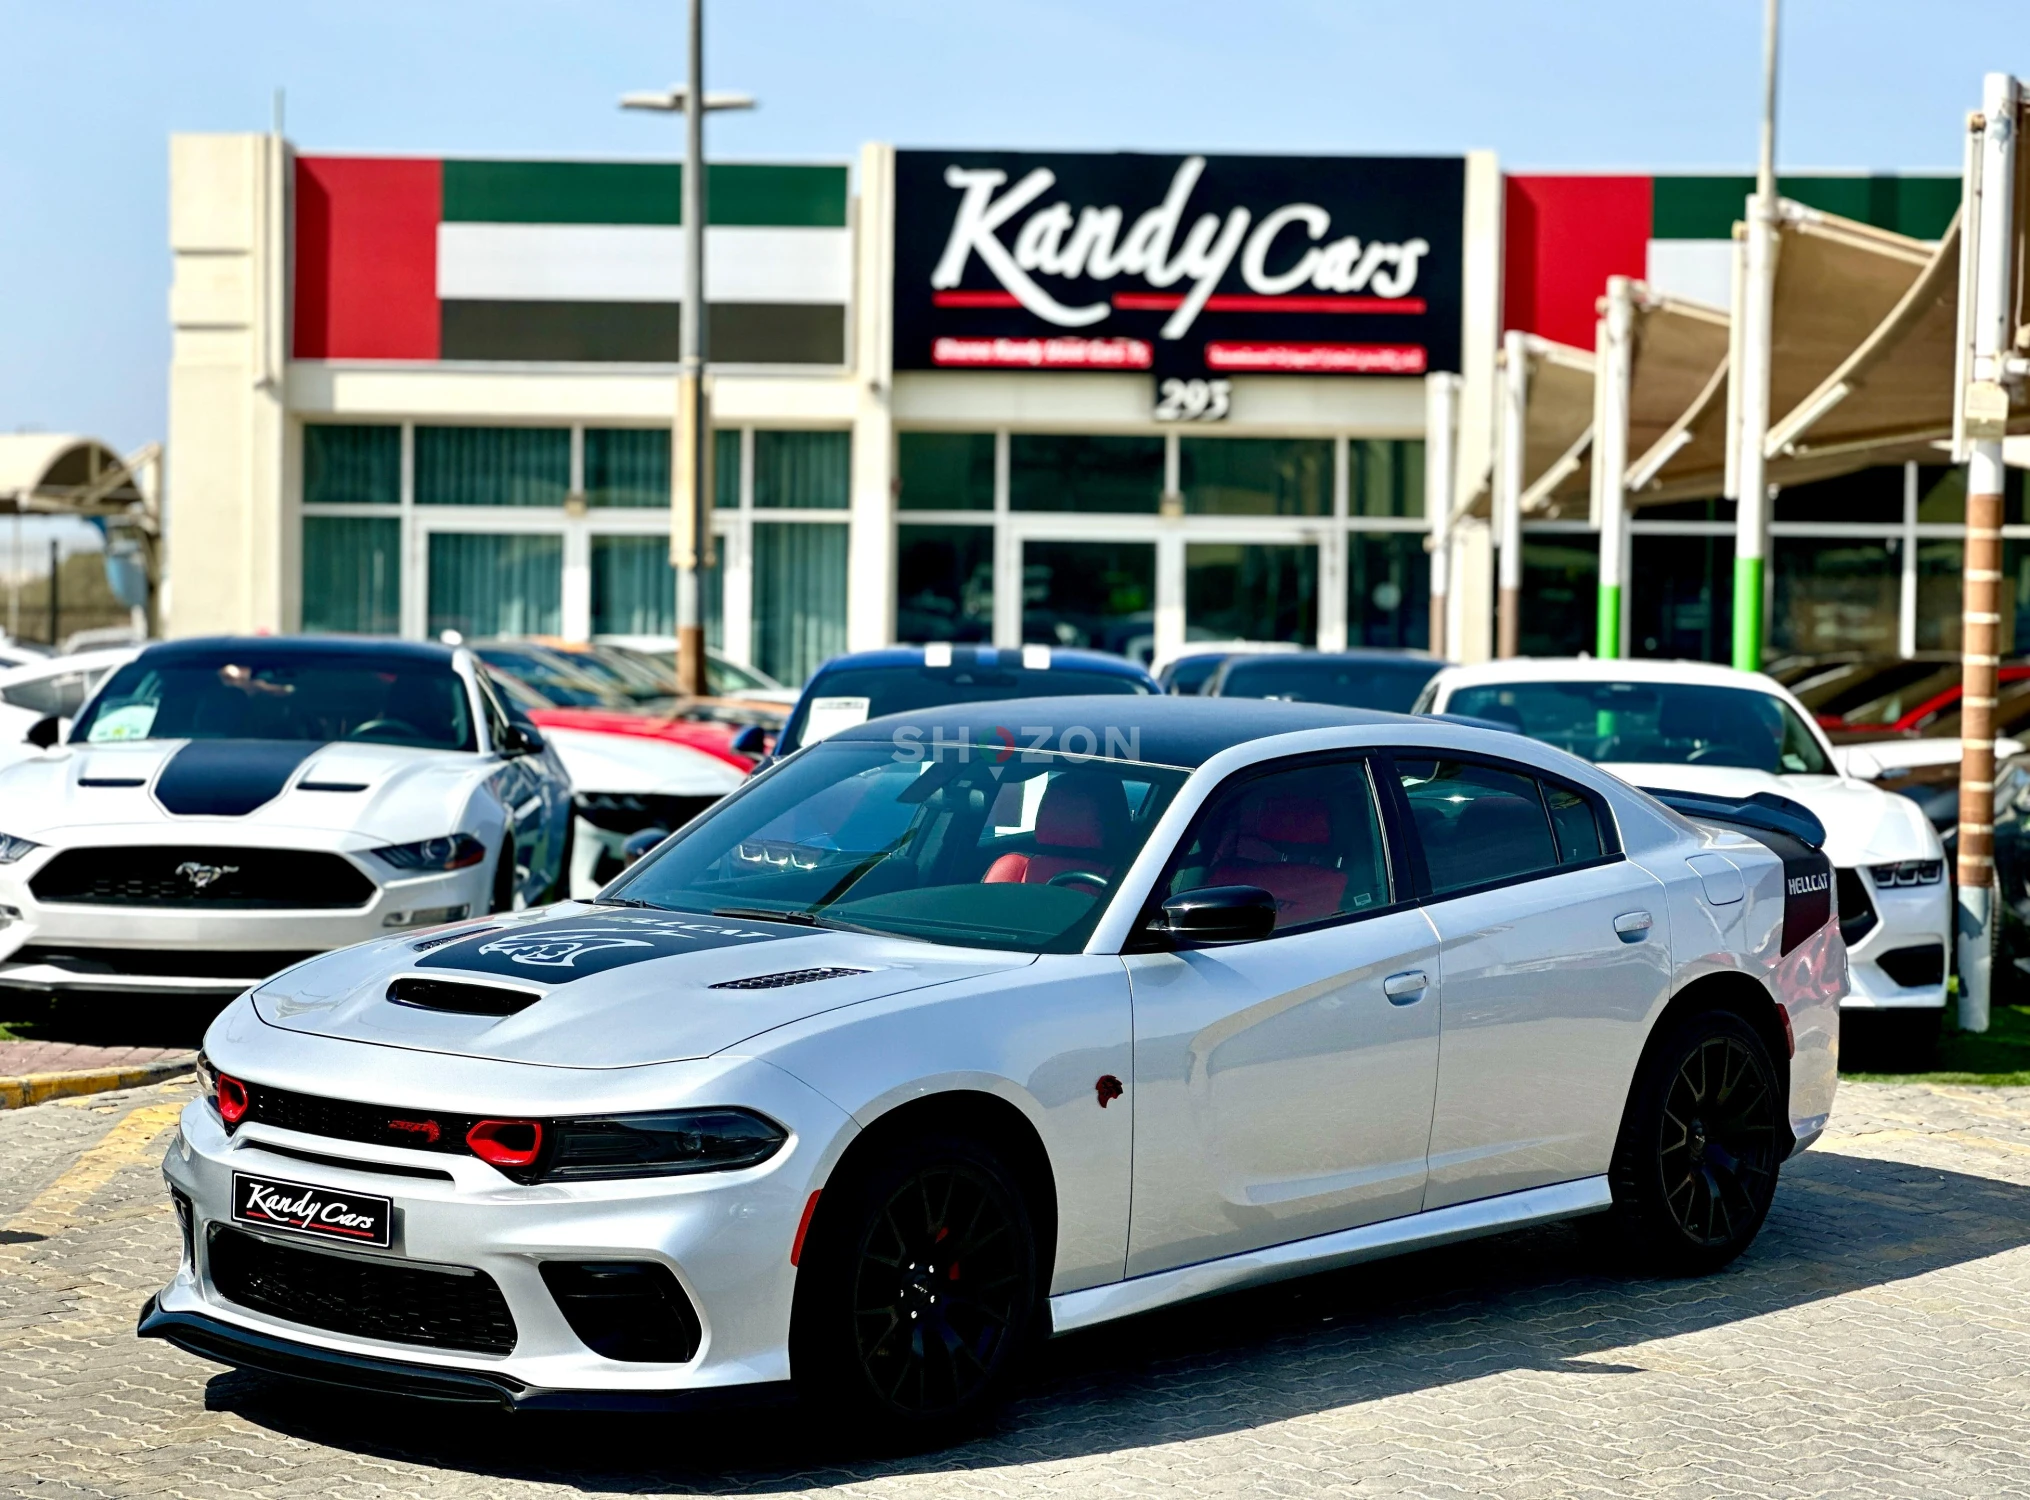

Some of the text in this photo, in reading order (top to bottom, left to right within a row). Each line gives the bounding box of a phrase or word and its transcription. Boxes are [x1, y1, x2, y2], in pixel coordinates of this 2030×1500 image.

[931, 157, 1429, 339] Kandy Cars
[1157, 377, 1231, 420] 295
[1788, 873, 1828, 895] HELLCAT
[246, 1183, 374, 1229] Kandy Cars
